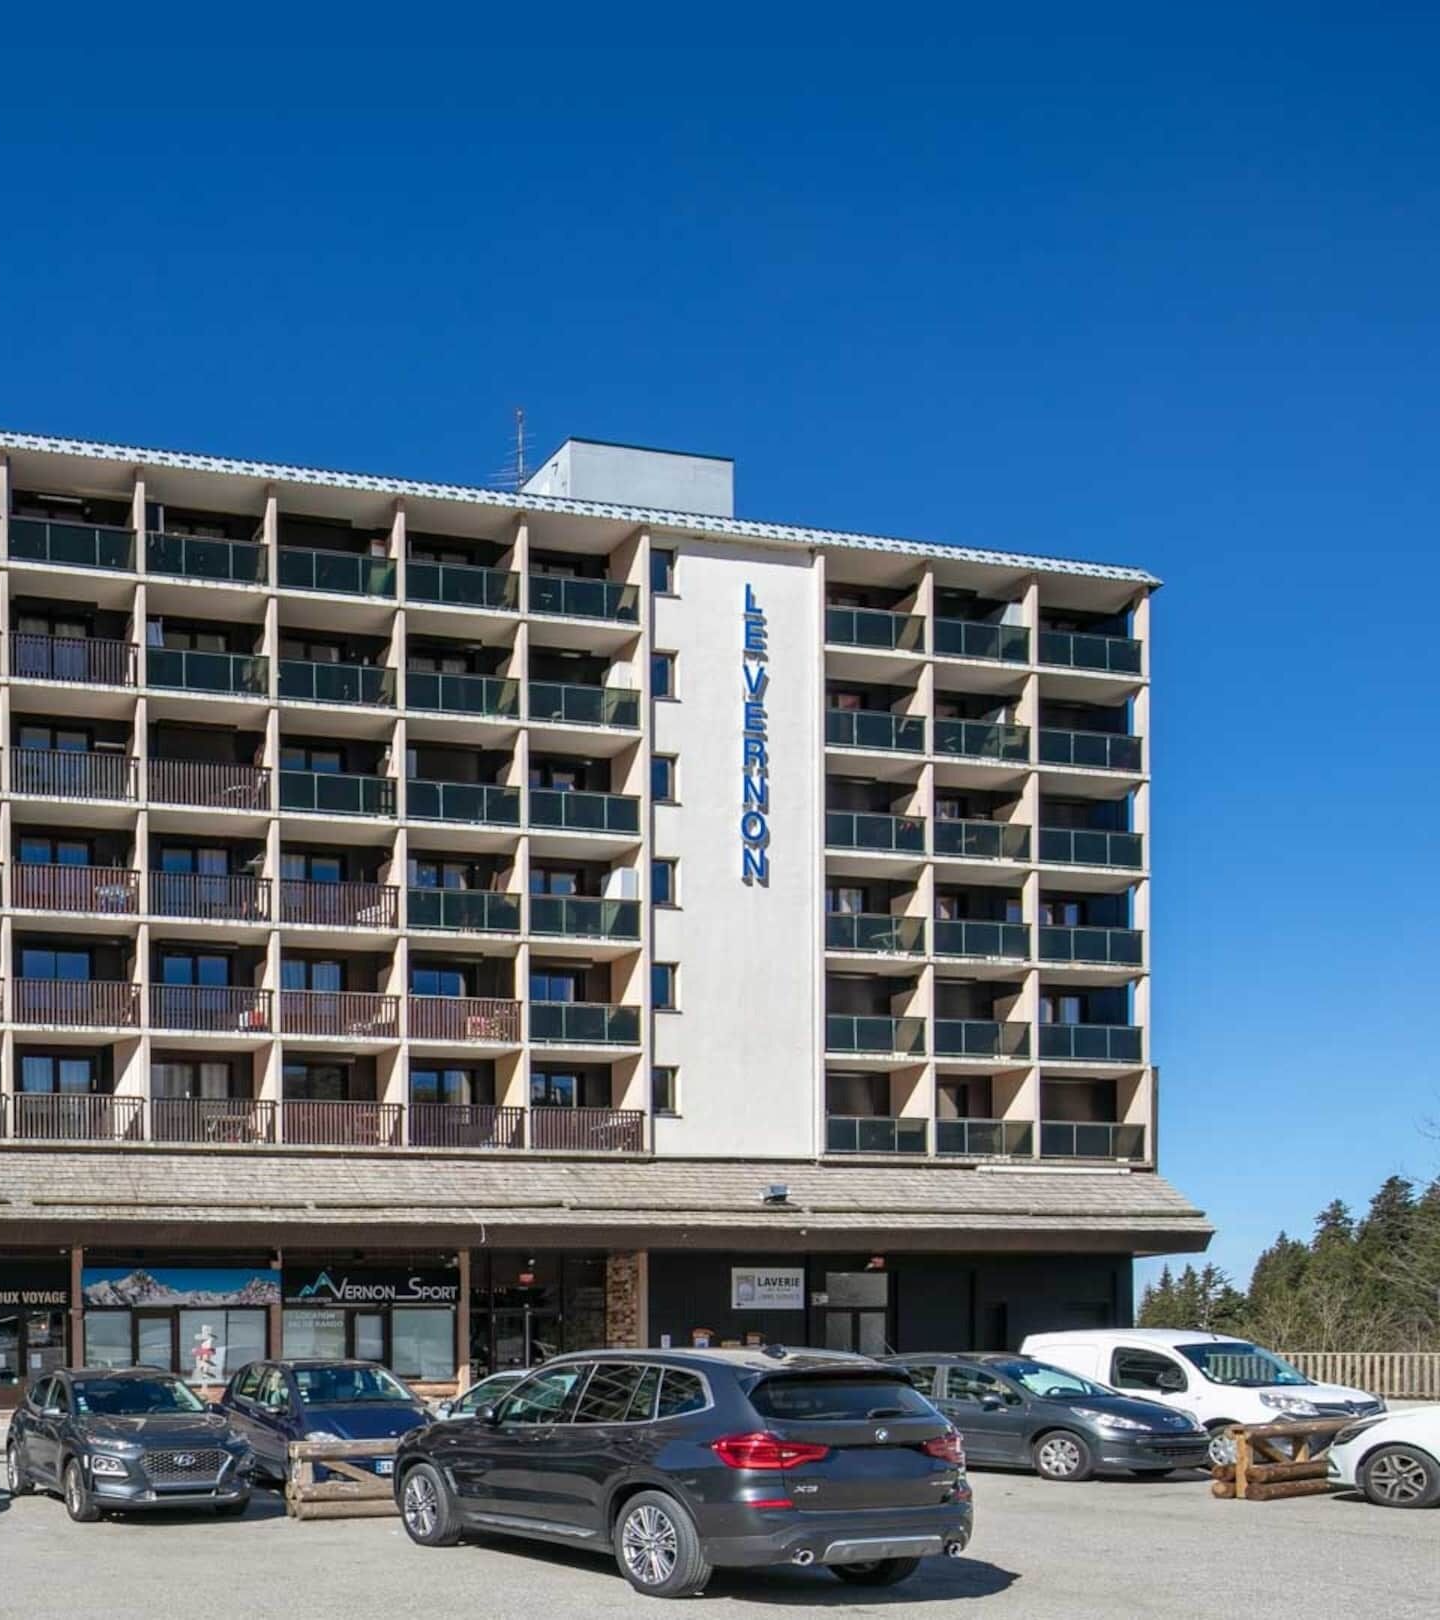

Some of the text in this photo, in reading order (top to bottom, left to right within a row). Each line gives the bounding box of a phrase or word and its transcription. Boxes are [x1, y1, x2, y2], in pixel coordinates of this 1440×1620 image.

[741, 583, 767, 880] LE VERNON
[333, 1277, 458, 1299] VERNON SPORT
[757, 1277, 800, 1287] LAVERIE
[22, 1291, 67, 1304] VOYAGE
[793, 1485, 819, 1494] X3
